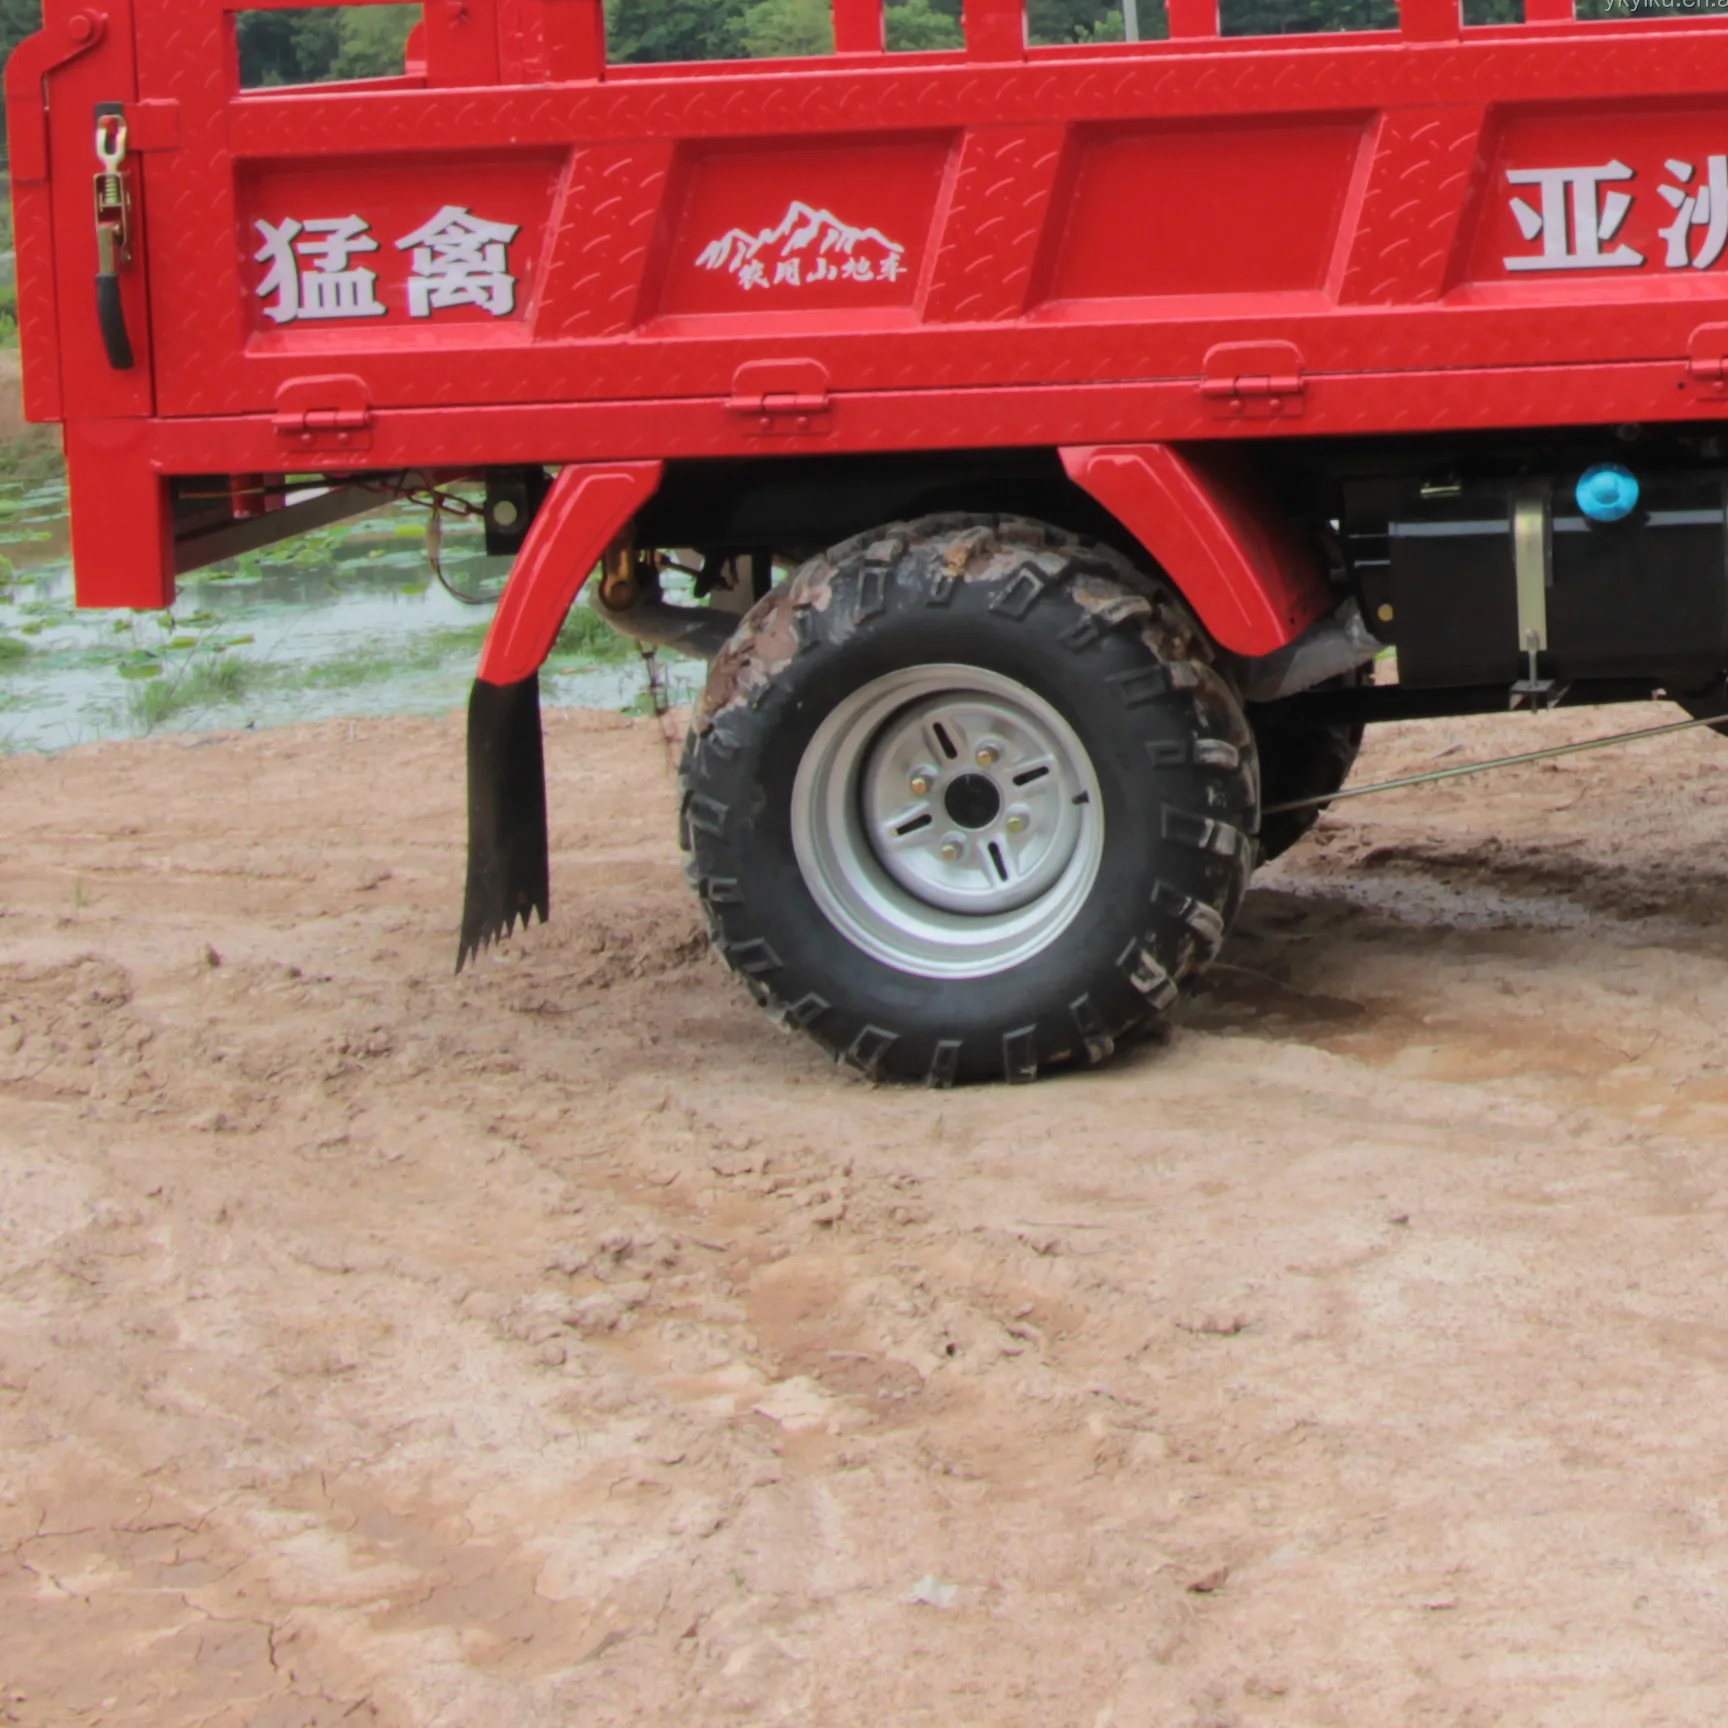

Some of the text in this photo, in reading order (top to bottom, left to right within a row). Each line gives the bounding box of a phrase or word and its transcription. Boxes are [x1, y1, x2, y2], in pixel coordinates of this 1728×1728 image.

[254, 205, 520, 323] 猛禽
[738, 252, 907, 290] 农用山地车
